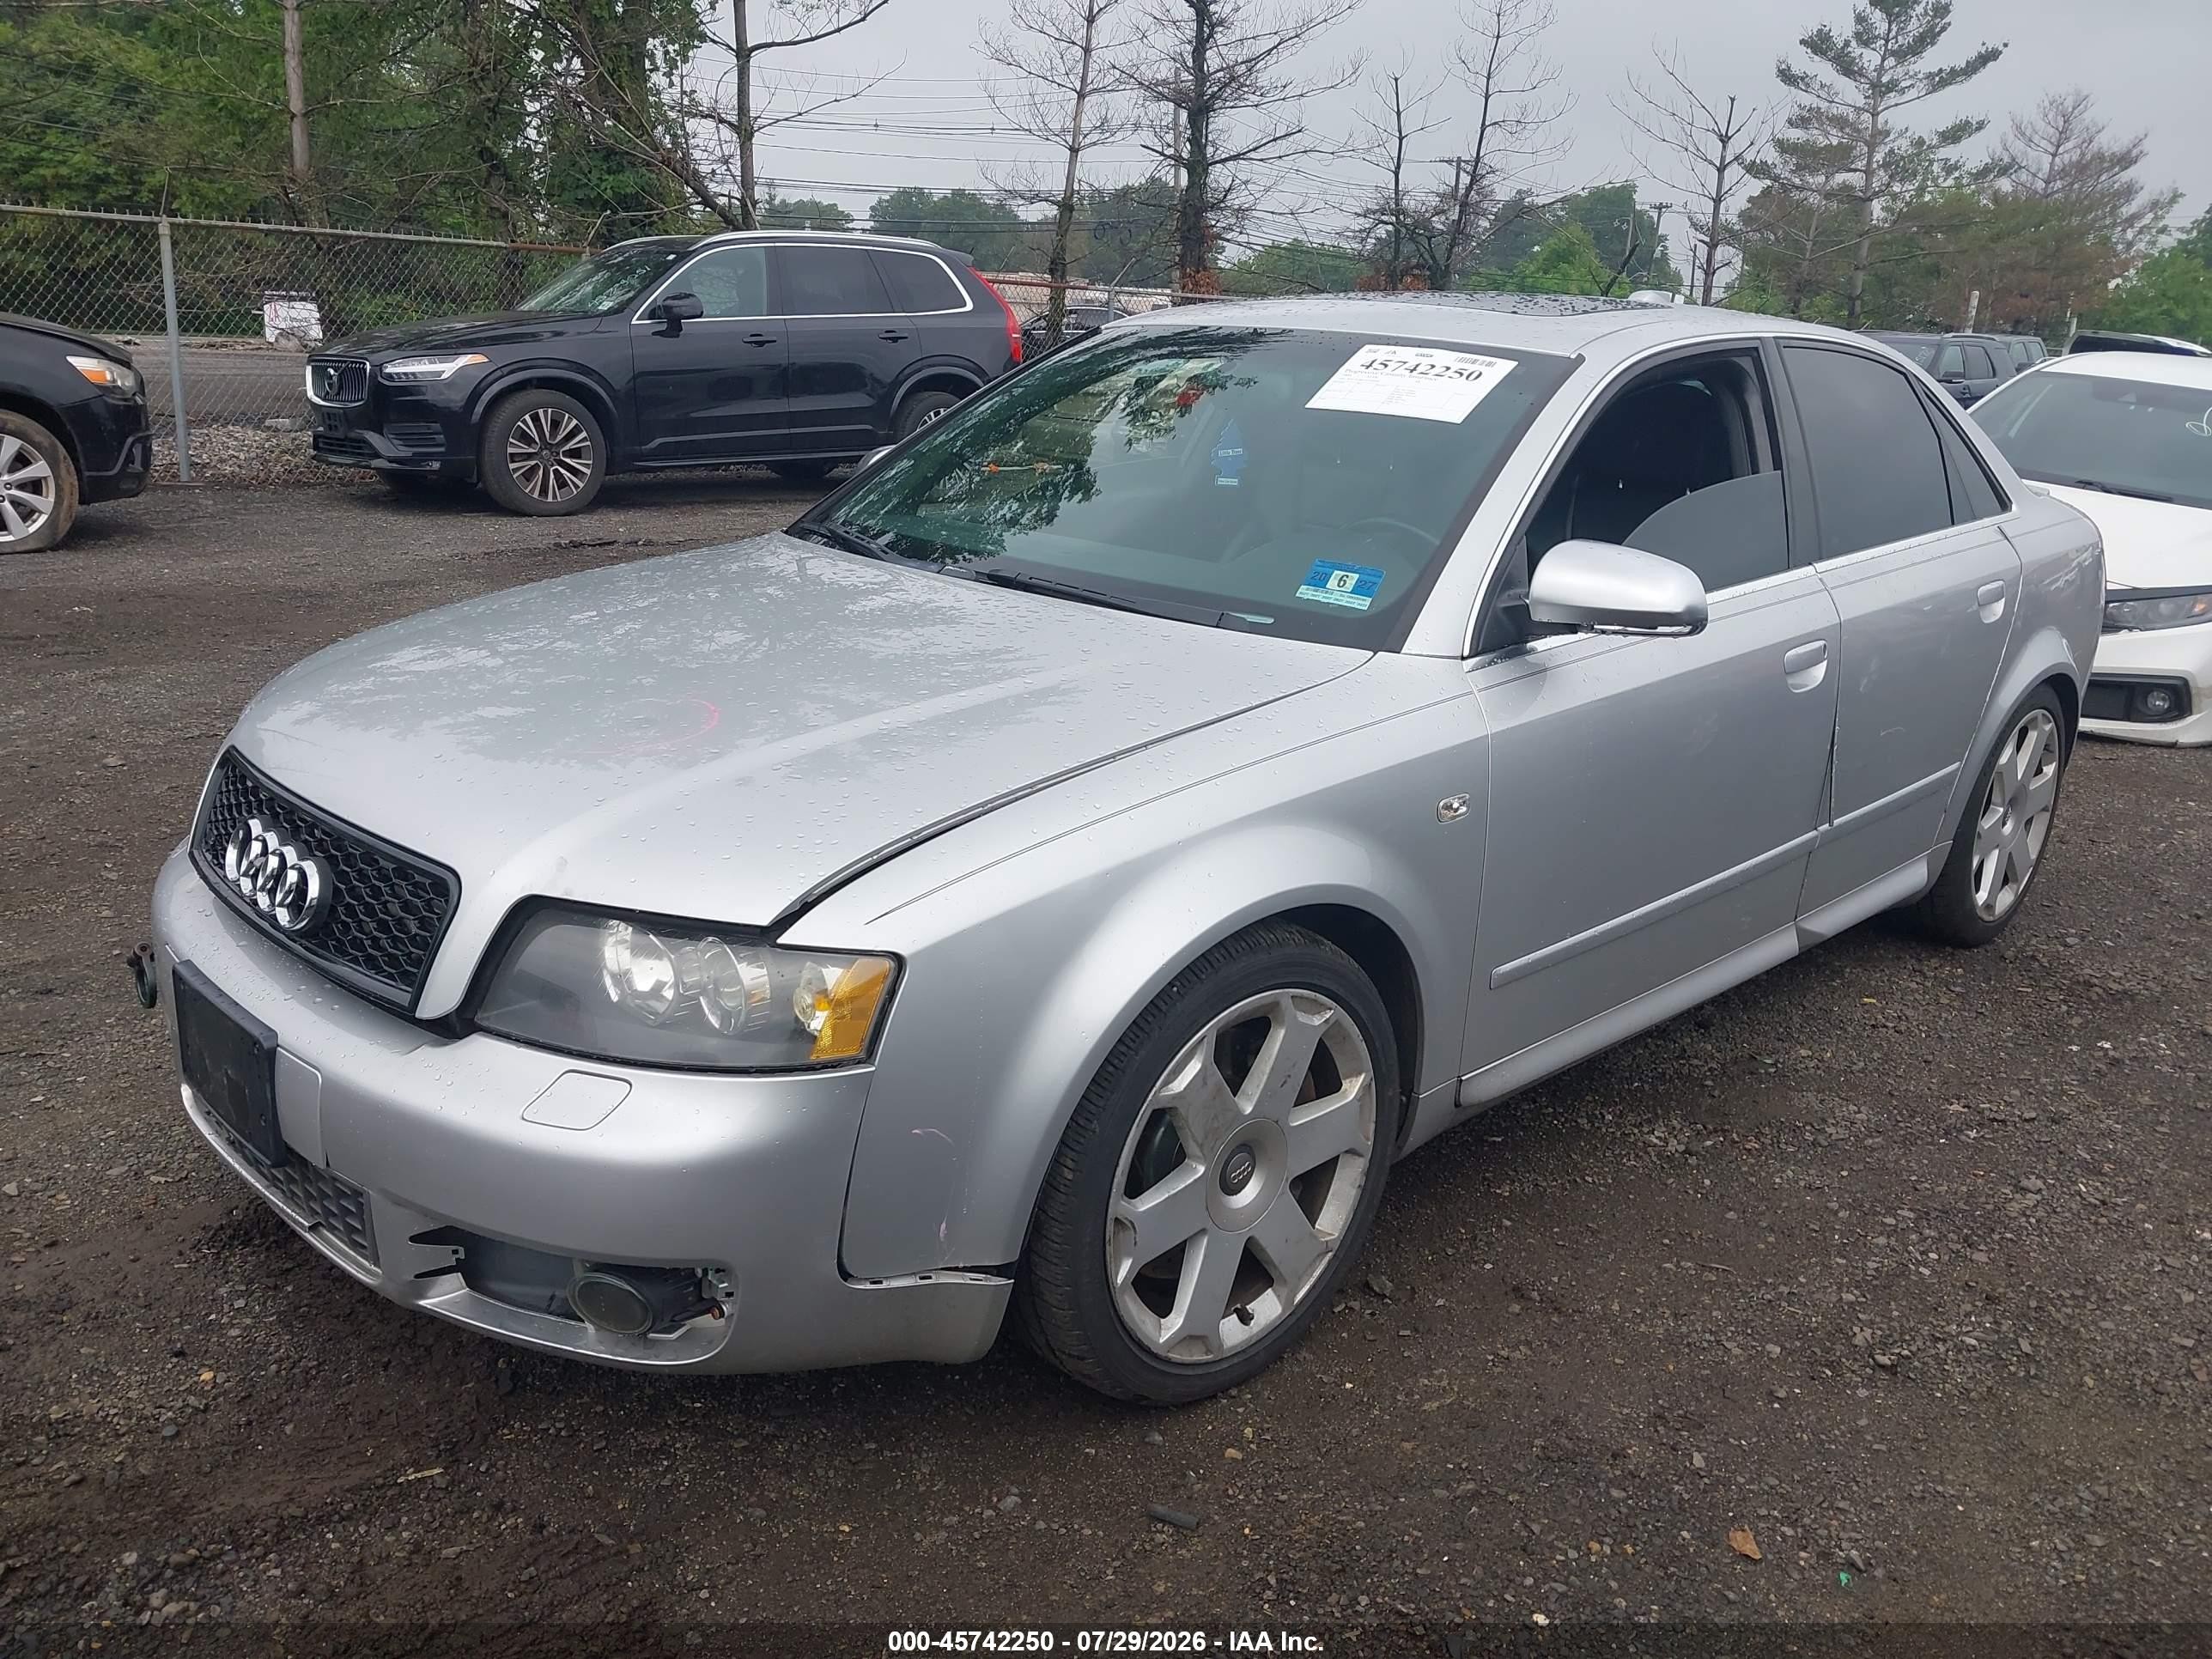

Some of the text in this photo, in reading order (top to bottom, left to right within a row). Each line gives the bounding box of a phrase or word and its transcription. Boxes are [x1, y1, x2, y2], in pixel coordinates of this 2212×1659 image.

[1360, 358, 1483, 382] 45742250
[1310, 571, 1377, 590] 20 6 27
